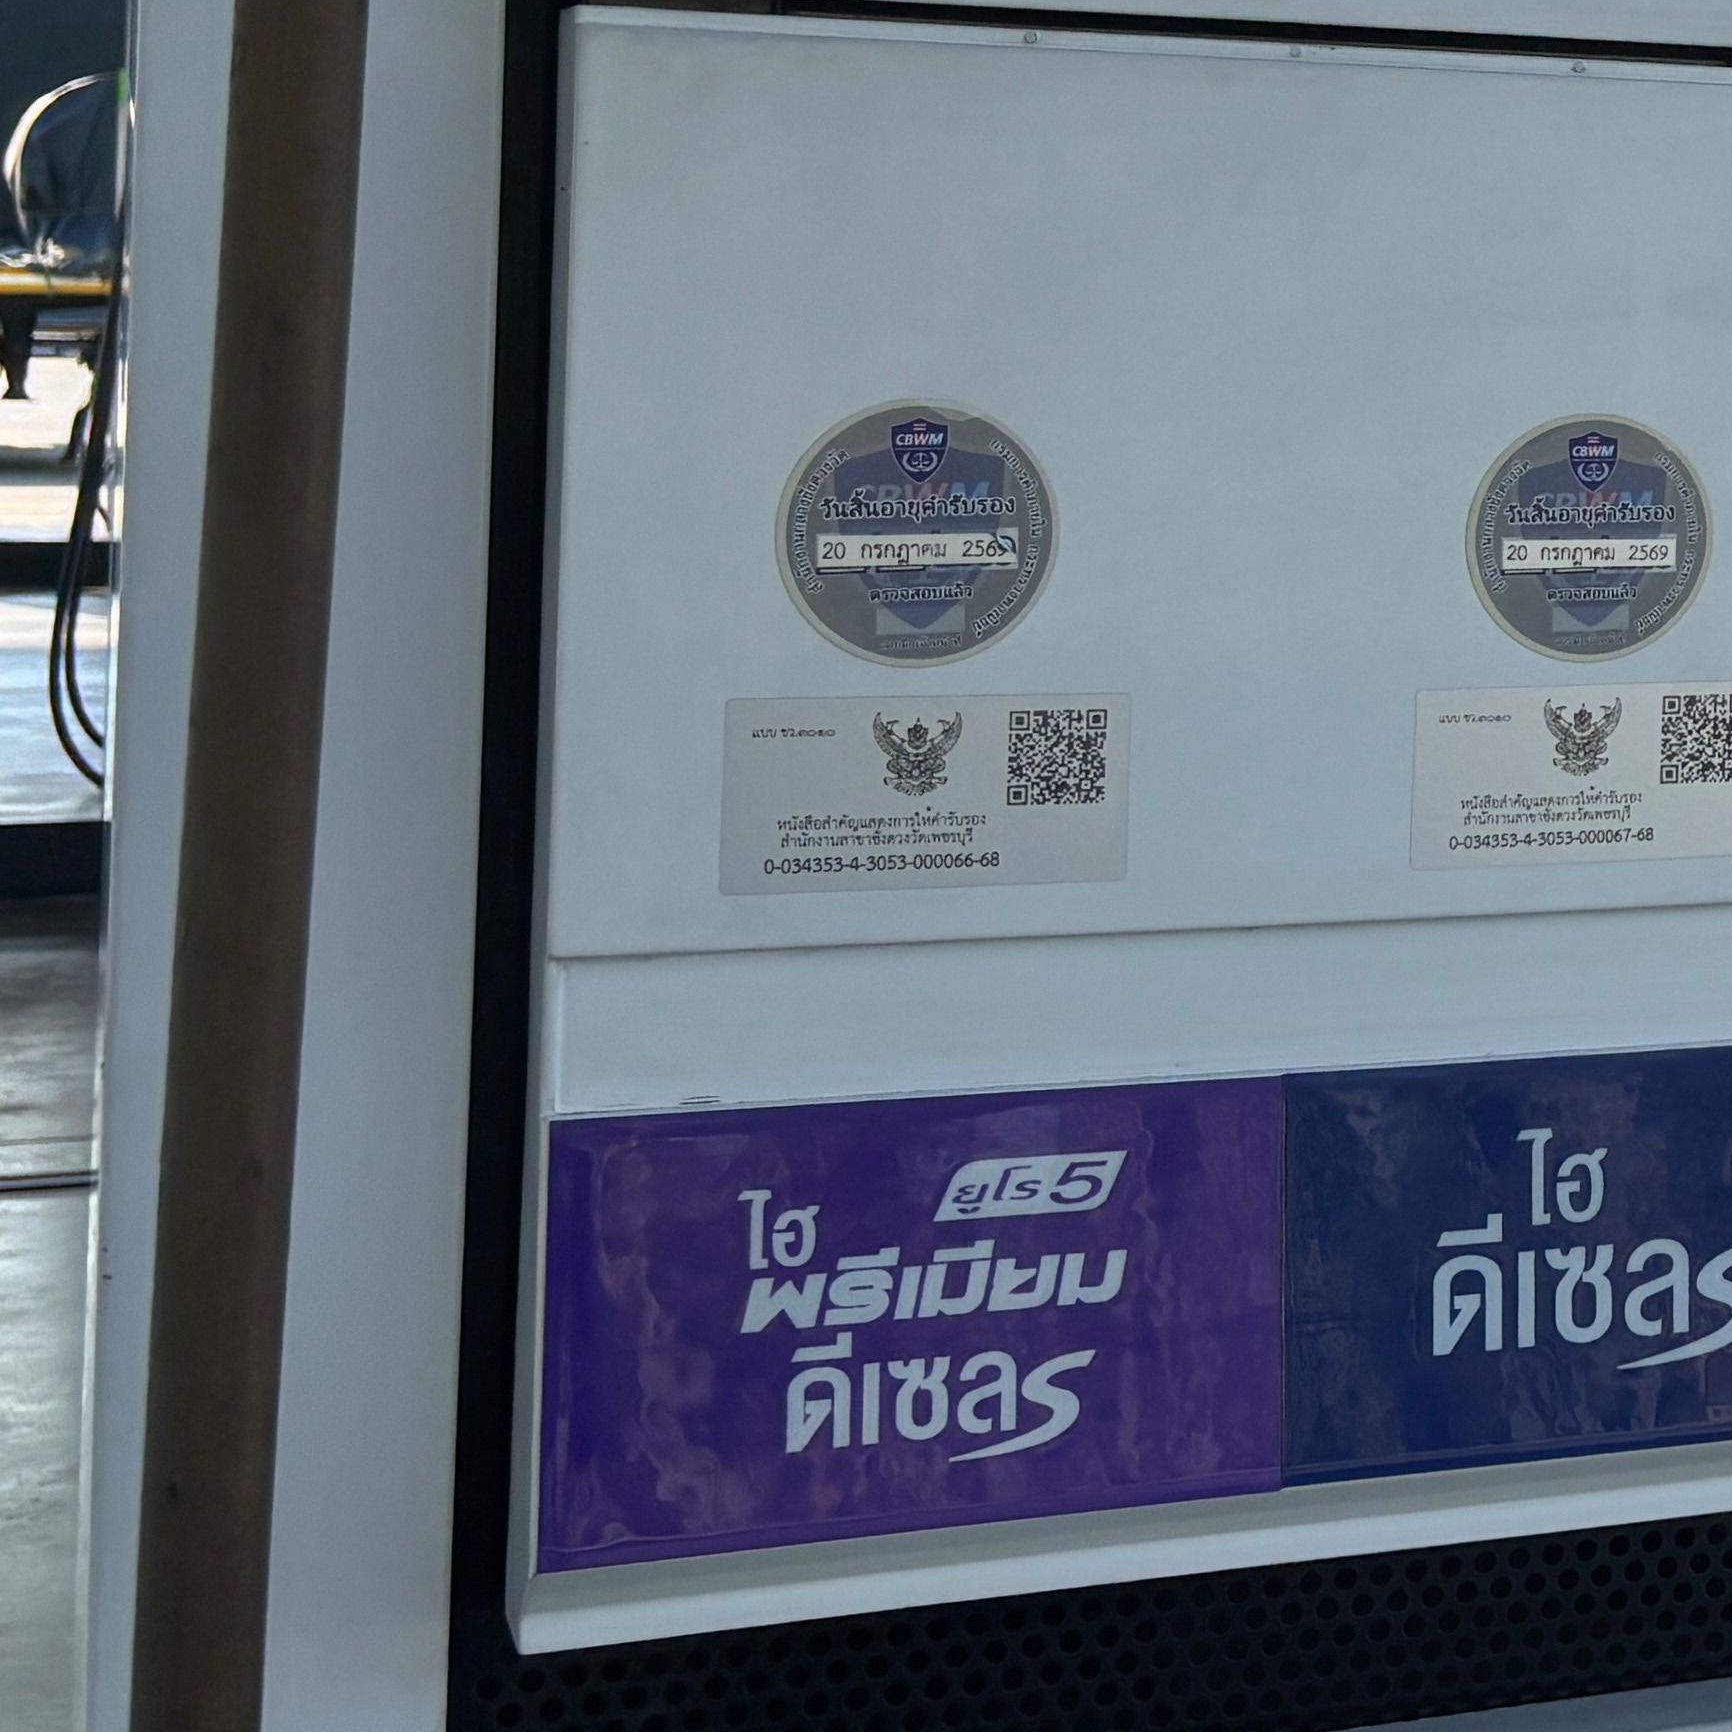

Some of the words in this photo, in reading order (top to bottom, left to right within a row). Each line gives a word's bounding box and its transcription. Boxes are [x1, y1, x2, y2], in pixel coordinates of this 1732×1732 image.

[895, 433, 944, 447] CBWM
[1572, 445, 1615, 458] CBWM
[819, 487, 1017, 524] วันสิ้นอายุคำรับรอง
[1505, 498, 1675, 529] วันสิ้นอายุคำรับรอง
[821, 541, 847, 560] 20
[860, 541, 948, 565] กรกฎาคม
[1506, 544, 1528, 561] 20
[1540, 547, 1616, 566] กรกฎาคม
[1628, 544, 1669, 561] 2569
[869, 582, 974, 603] ตรวจสอบแล้ว
[764, 851, 1001, 875] 0-034353-4-3053-000066-68
[1516, 1127, 1608, 1226] ไฮ
[737, 1189, 820, 1270] ไฮ
[740, 1239, 1127, 1334] พรีเมียม
